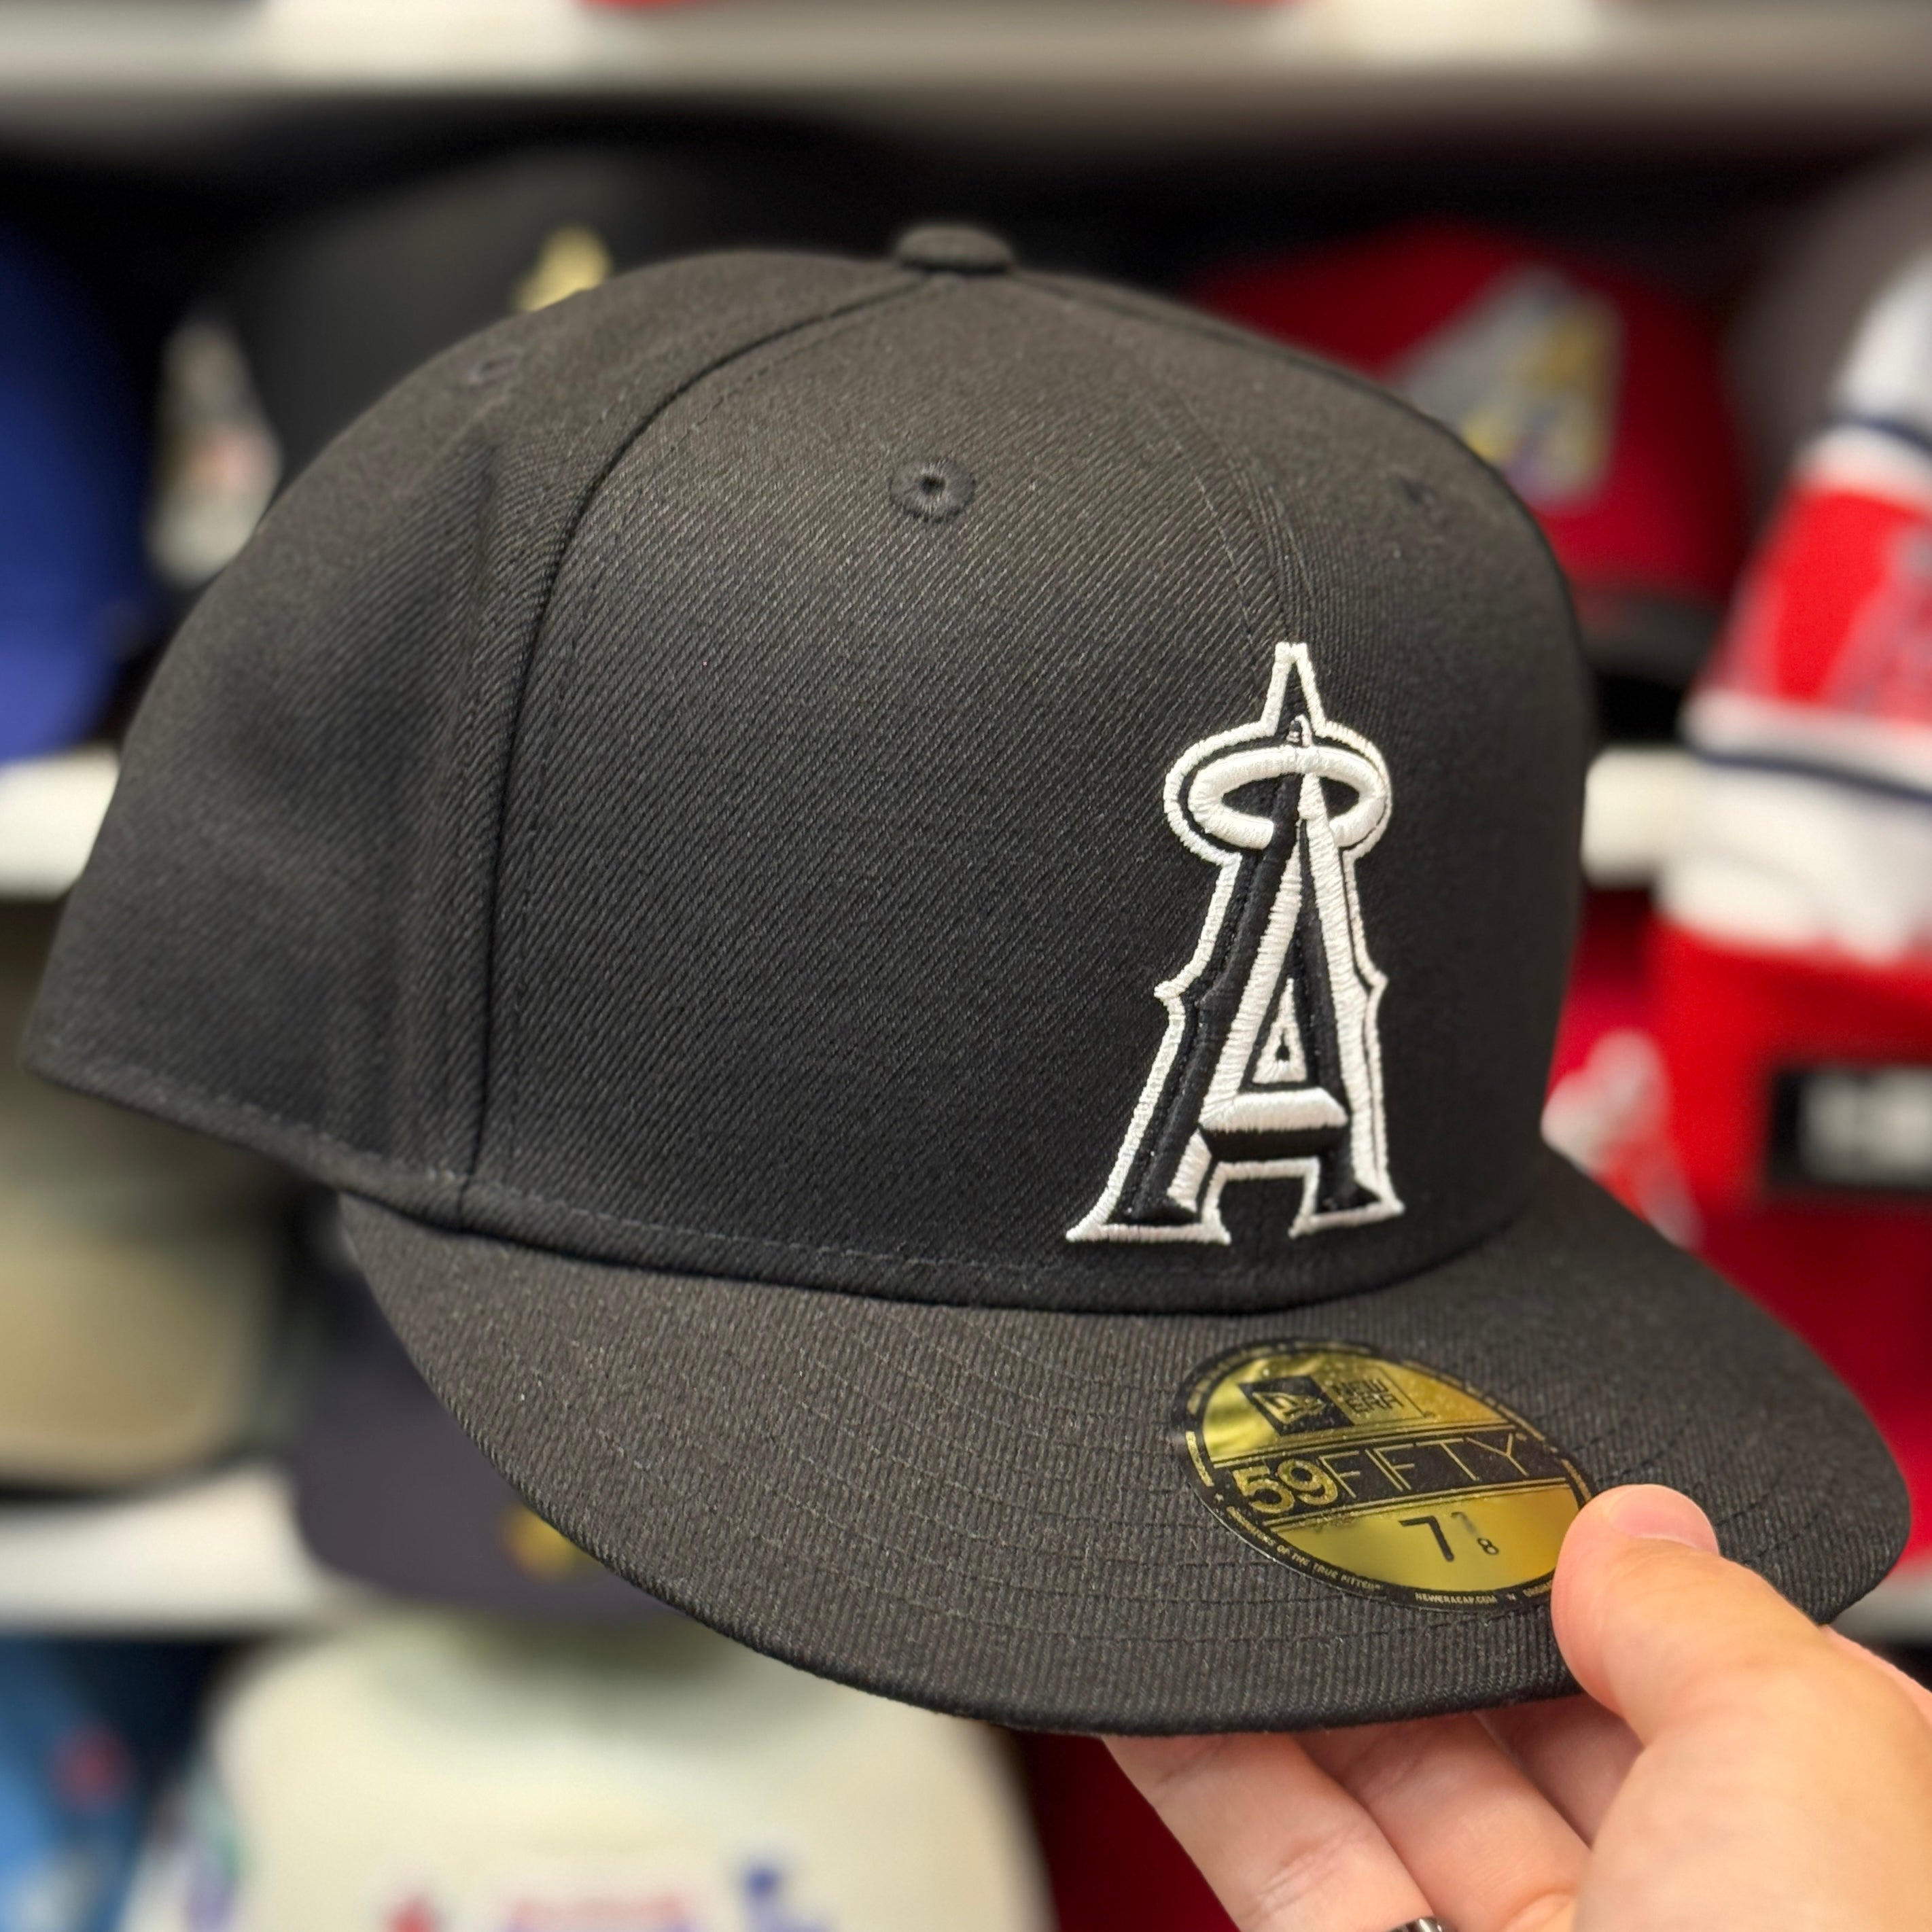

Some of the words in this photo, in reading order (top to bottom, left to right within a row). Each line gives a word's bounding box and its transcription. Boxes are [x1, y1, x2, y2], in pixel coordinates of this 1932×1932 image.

[1066, 642, 1405, 1244] A
[1332, 1379, 1389, 1396] NEW
[1346, 1393, 1405, 1412] ERA
[1233, 1433, 1529, 1514] 59FIFTY
[1398, 1515, 1454, 1562] 7
[1292, 1553, 1310, 1566] THE
[1313, 1562, 1338, 1579] TRUE
